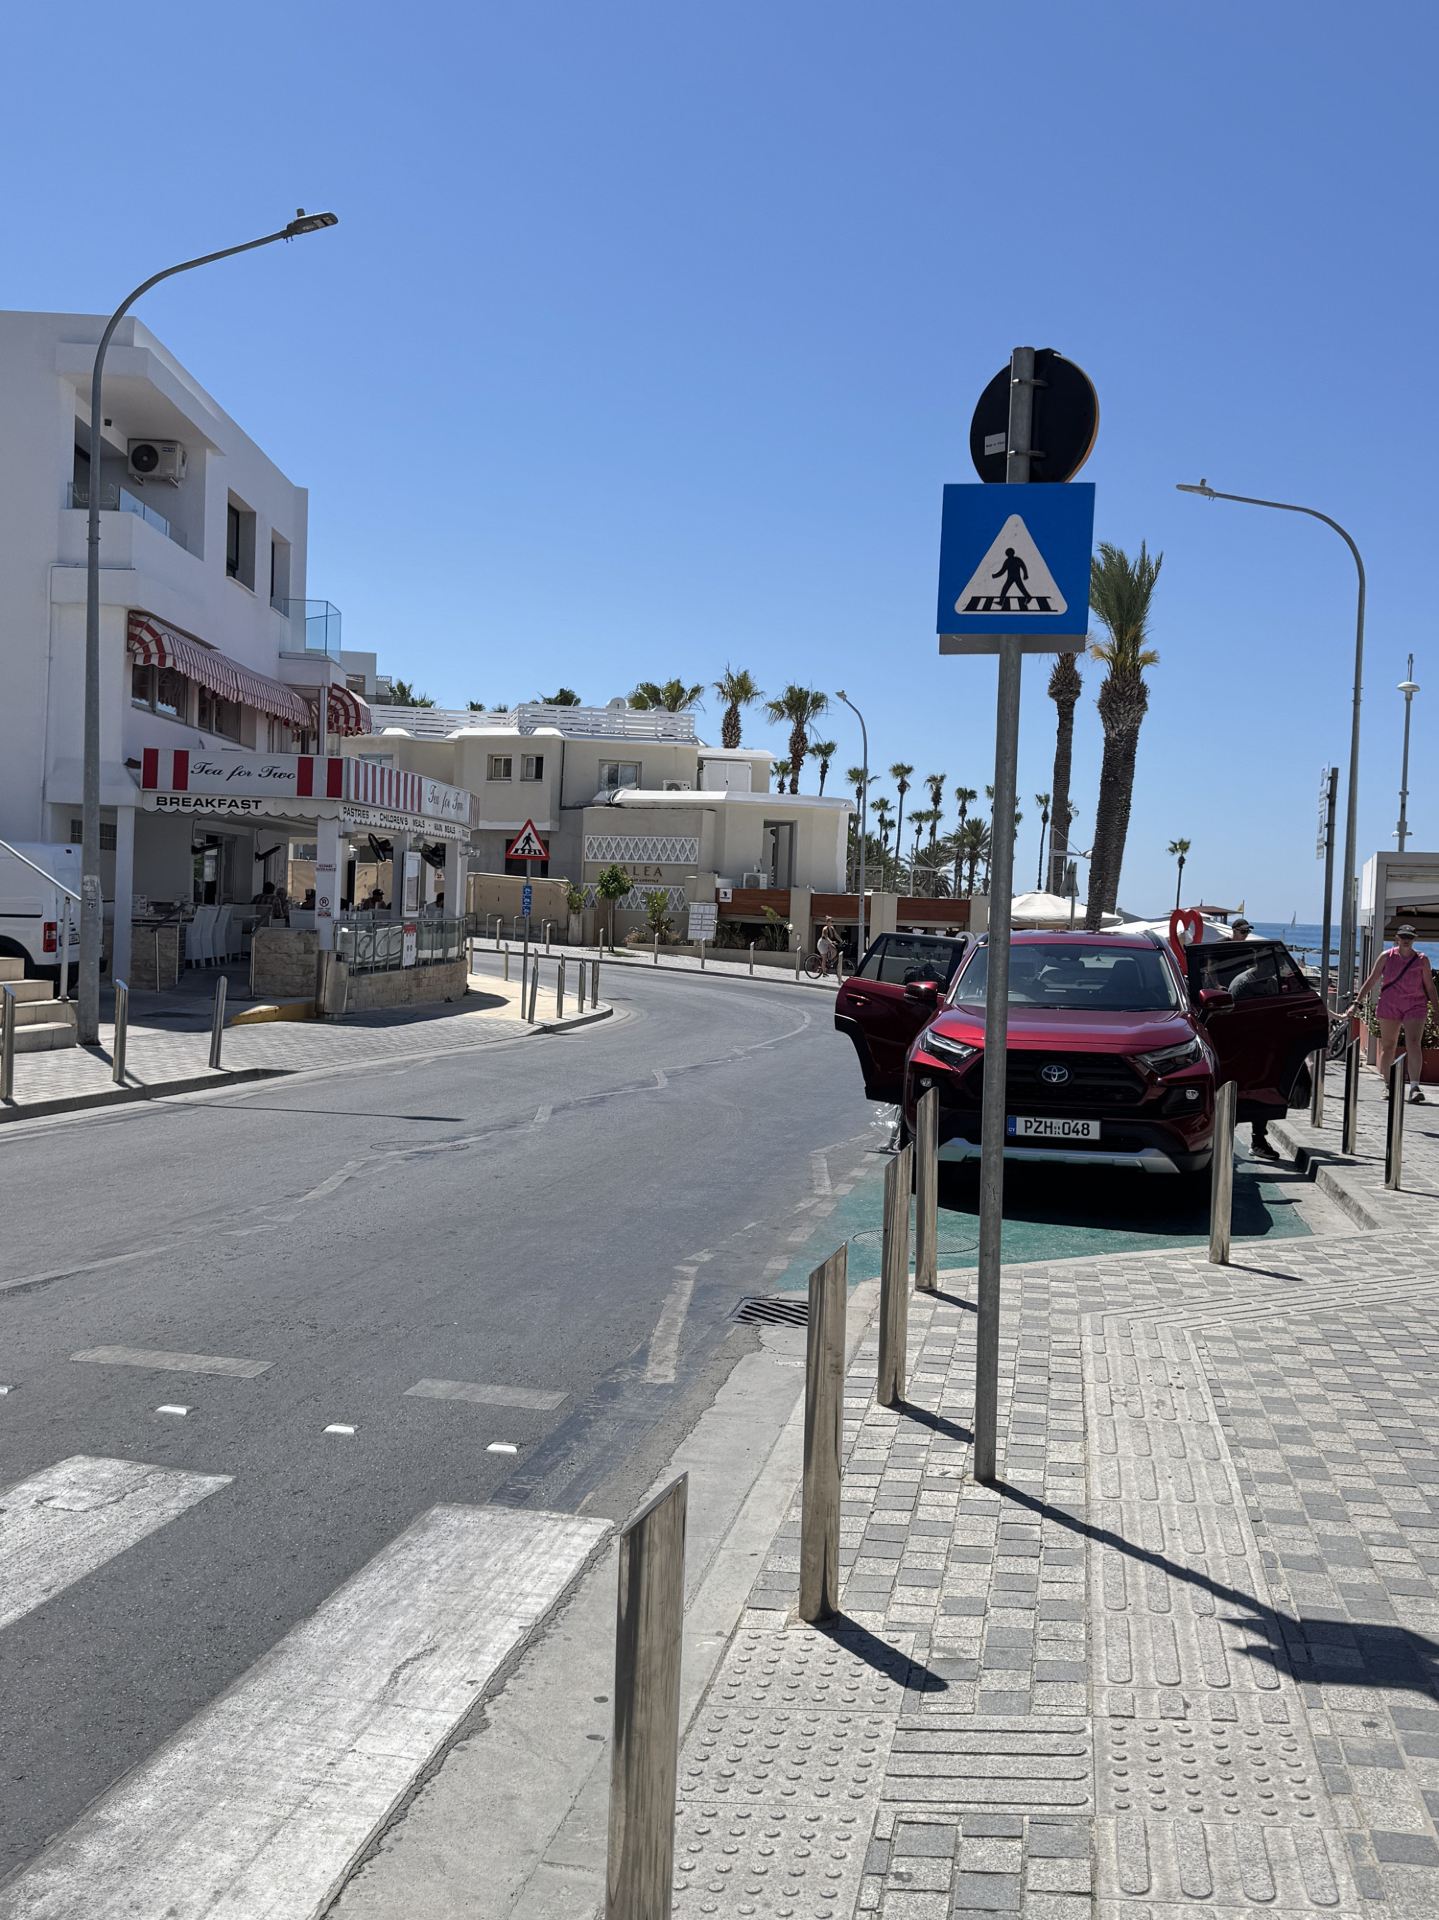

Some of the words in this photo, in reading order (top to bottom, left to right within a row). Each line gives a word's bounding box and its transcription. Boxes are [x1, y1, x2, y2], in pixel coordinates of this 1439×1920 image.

[190, 761, 224, 776] Tea
[226, 765, 253, 782] for
[258, 766, 296, 780] Two
[156, 796, 262, 810] BREAKFAST
[343, 806, 370, 819] PASTRIES
[380, 812, 408, 826] CHILDREN'S
[412, 818, 425, 828] MEALS
